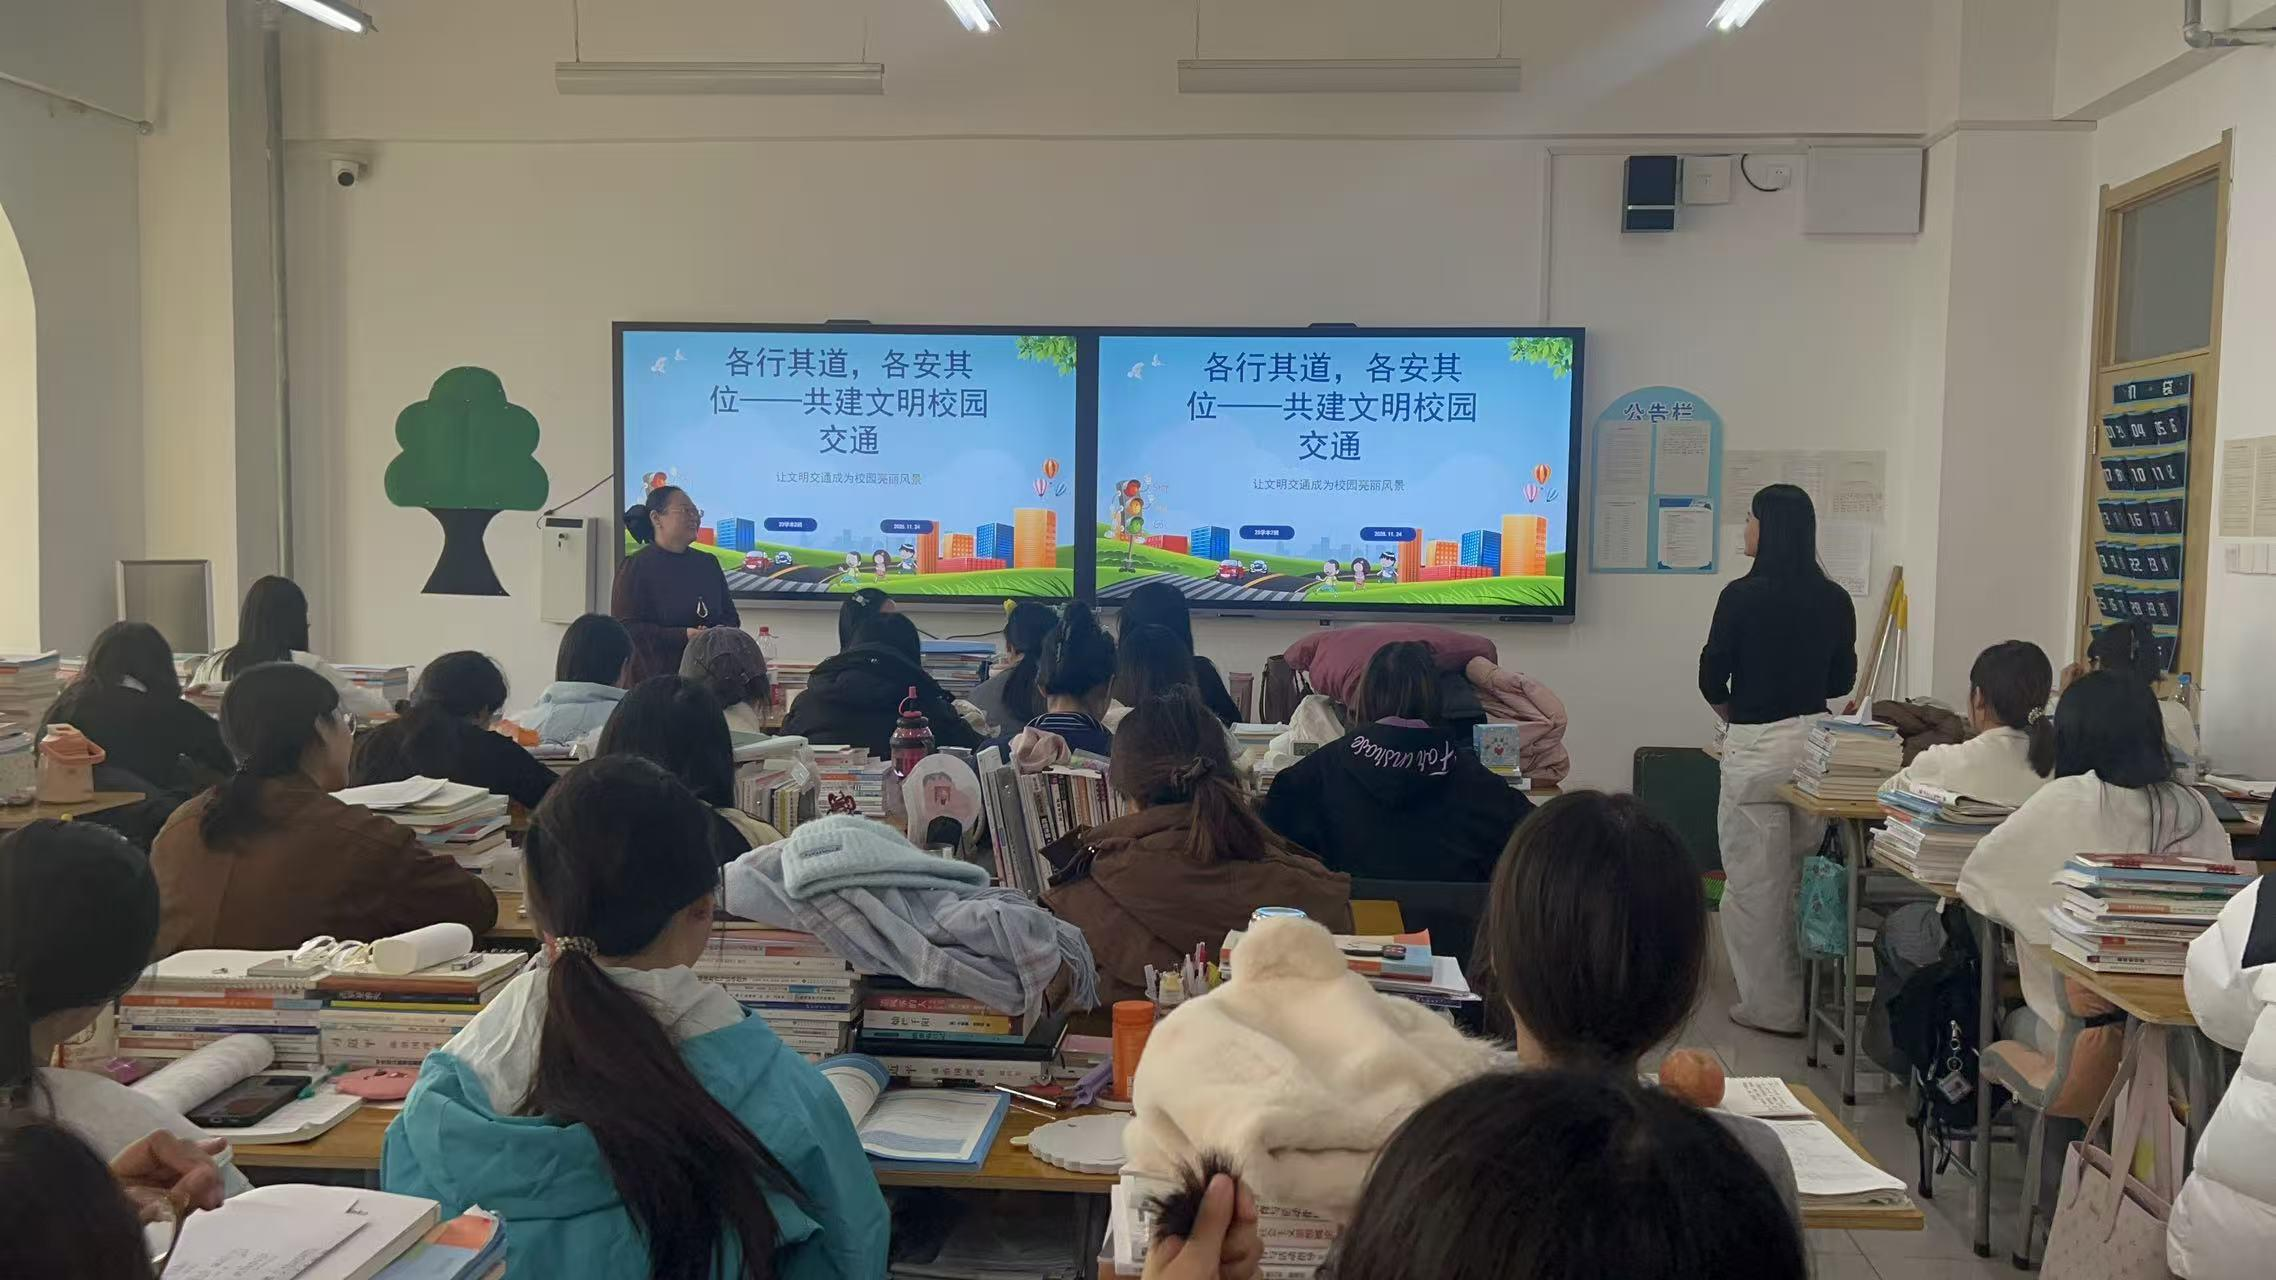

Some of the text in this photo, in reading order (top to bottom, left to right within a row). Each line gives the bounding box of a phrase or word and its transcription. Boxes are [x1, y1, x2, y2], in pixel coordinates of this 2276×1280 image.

[725, 346, 973, 380] 各行其道，各安其
[1203, 351, 1462, 385] 各行其道，各安其
[710, 386, 988, 419] 位——共建文明校园
[1186, 391, 1477, 423] 位——共建文明校园
[1624, 402, 1693, 423] 公告栏
[819, 424, 880, 456] 交通
[2131, 424, 2146, 437] 04
[1298, 430, 1362, 461] 交通
[776, 471, 922, 486] 让文明交通成为校园亮丽风景
[1252, 478, 1406, 492] 让文明交通成为校园亮丽风景
[2131, 468, 2146, 482] 10
[2152, 466, 2164, 480] 11
[2128, 513, 2143, 526] 16
